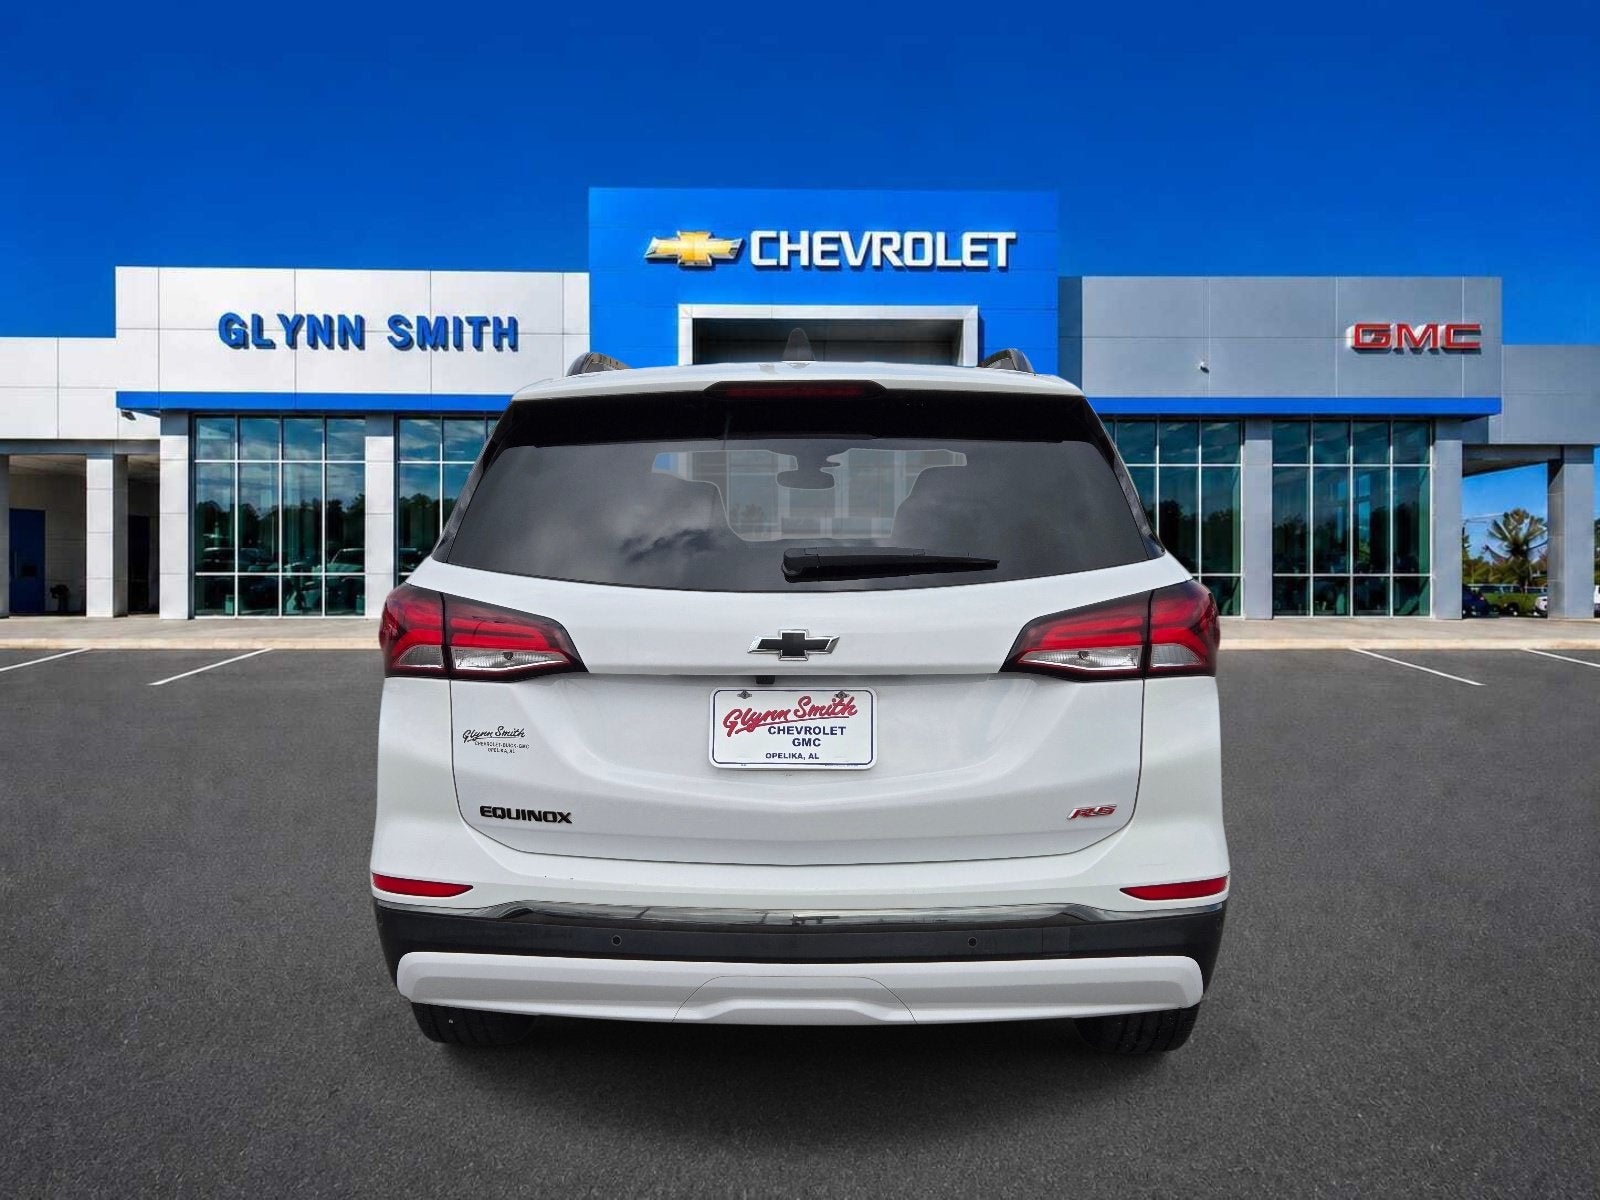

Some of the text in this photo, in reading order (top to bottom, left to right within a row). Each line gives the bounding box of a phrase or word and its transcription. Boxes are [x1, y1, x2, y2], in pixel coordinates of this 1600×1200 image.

[750, 230, 1017, 270] CHEVROLET
[218, 312, 519, 352] GLYNN SMITH
[1347, 323, 1482, 354] GMC
[723, 695, 858, 738] Glynn Smith
[494, 725, 526, 738] Smith
[767, 726, 846, 736] CHEVROLET
[791, 737, 822, 748] GMC
[765, 752, 820, 761] OPELIKA, AL
[479, 805, 573, 824] EQUINOX
[1066, 804, 1118, 821] RS
